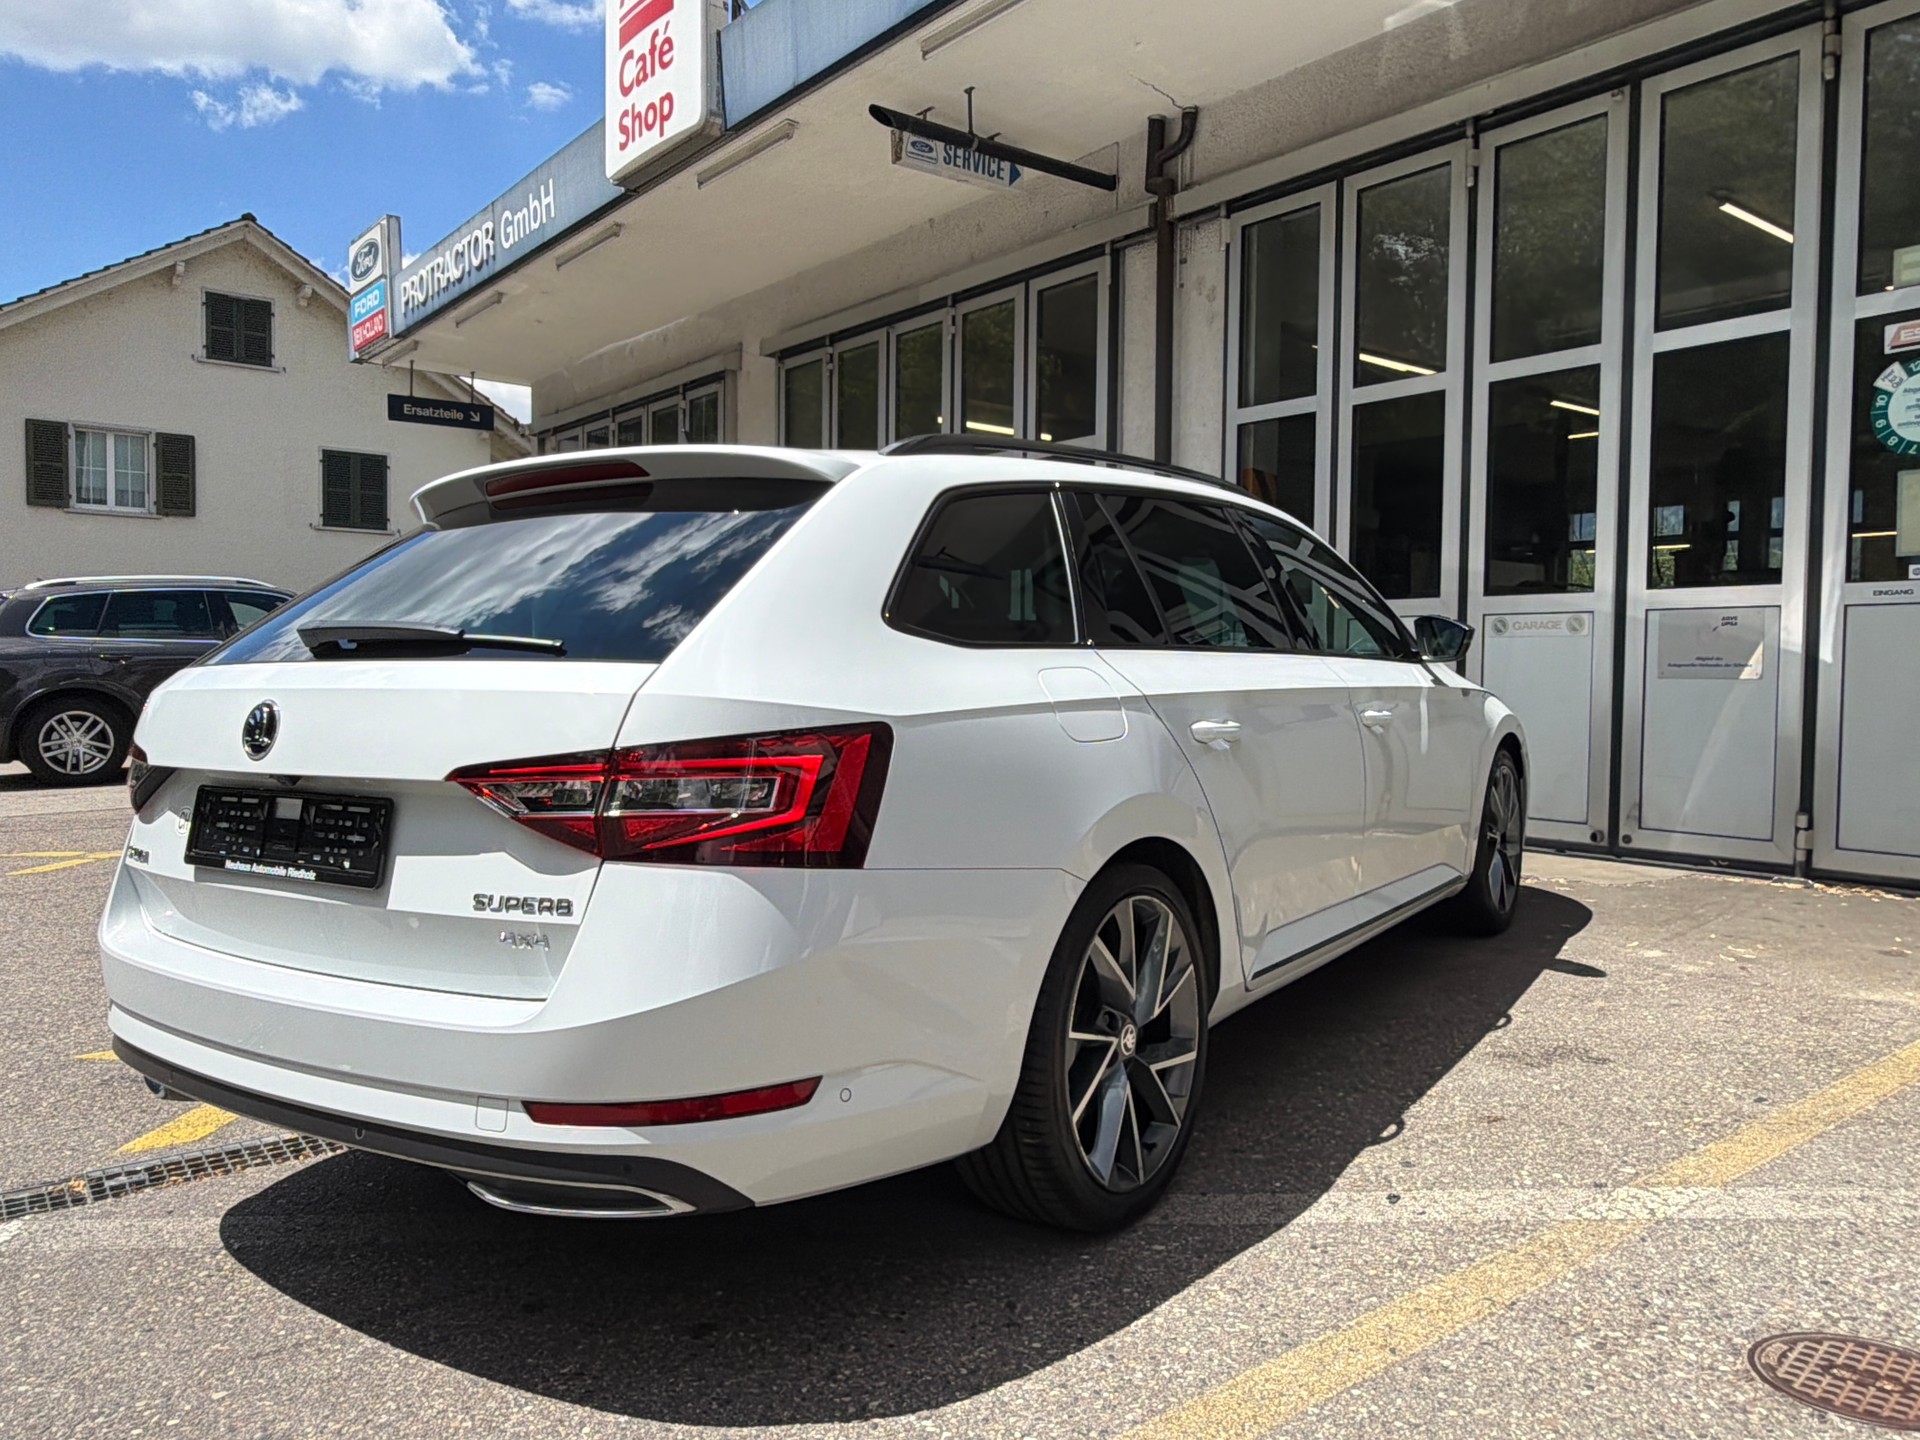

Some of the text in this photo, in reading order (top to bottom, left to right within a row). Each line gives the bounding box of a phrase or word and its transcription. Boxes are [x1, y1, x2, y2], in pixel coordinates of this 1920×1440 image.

[619, 20, 674, 97] Café
[619, 92, 674, 151] Shop
[943, 143, 1005, 180] SERVICE
[400, 178, 555, 314] PROTRACTOR GmbH
[355, 246, 376, 276] Ford
[354, 289, 379, 318] FORD
[403, 403, 464, 421] Ersatzteile
[1876, 394, 1888, 408] 10
[1873, 588, 1915, 597] EINGANG
[1512, 620, 1562, 631] GARAGE
[473, 893, 573, 917] SUPERB
